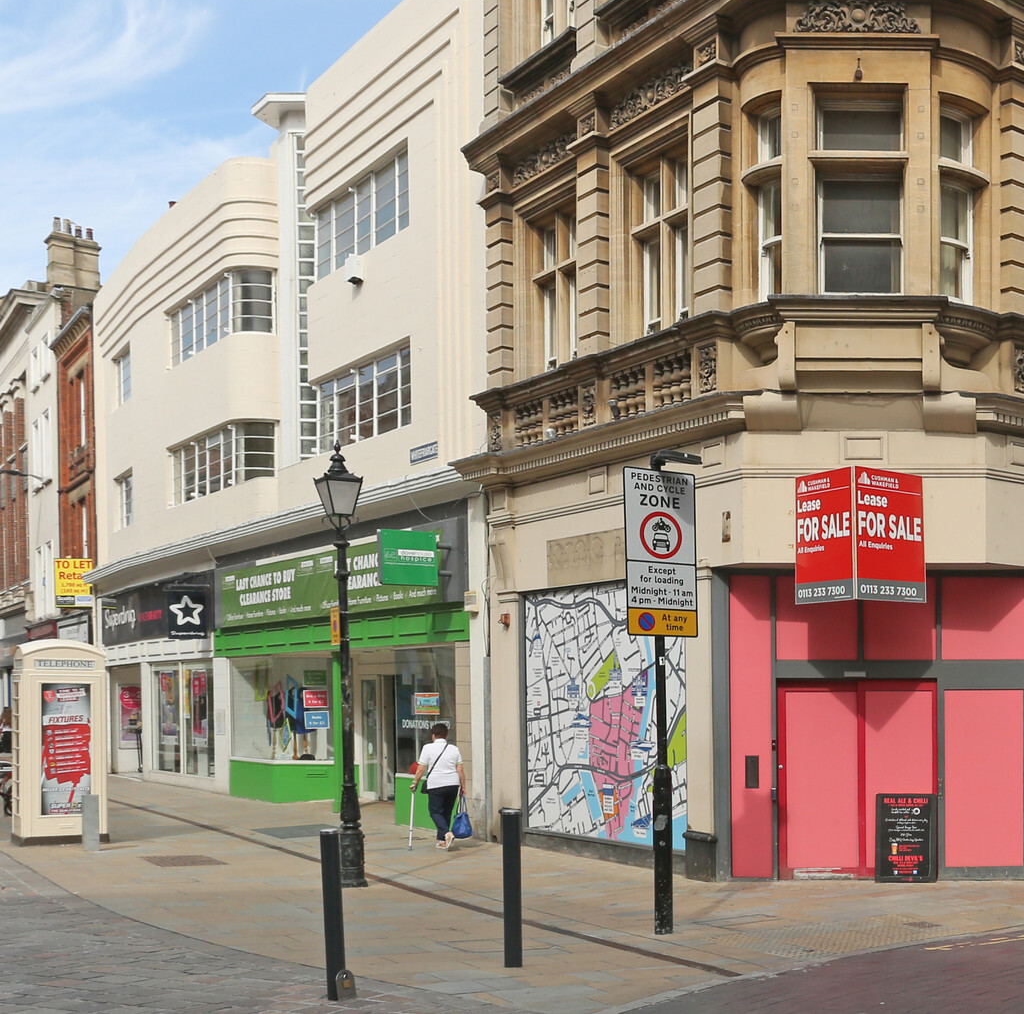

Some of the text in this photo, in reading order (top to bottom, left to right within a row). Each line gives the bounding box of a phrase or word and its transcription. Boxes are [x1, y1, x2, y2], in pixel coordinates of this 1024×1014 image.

[631, 472, 688, 486] PEDESTRIAN
[871, 475, 895, 483] CUSHMAN
[634, 482, 686, 495] AND CYCLE
[807, 483, 831, 492] WAKEFIELD
[871, 480, 899, 489] WAKEFIELD
[640, 494, 680, 509] ZONE
[857, 490, 888, 508] Lease
[797, 499, 821, 514] Lease
[797, 511, 851, 543] FOR SALE
[857, 510, 922, 542] FOR SALE
[804, 545, 825, 553] Enquiries
[858, 540, 893, 550] All Enquiries
[55, 560, 92, 569] TO LET
[353, 552, 380, 570] CHANC
[58, 571, 87, 580] Reta
[648, 566, 676, 576] Except
[236, 577, 249, 591] LAST
[249, 573, 272, 589] CHANCE
[272, 571, 282, 585] TO
[283, 568, 296, 583] BUY
[347, 572, 382, 590] EARANC
[640, 575, 684, 586] for loading
[631, 586, 667, 596] Midnight
[798, 585, 846, 598] 0113 233 7300
[860, 584, 917, 596] 0113 233 7300
[240, 586, 292, 606] CLEARANCE STORE
[658, 598, 694, 608] Midnight
[104, 606, 137, 631] Superdrug
[662, 614, 688, 623] At any
[666, 624, 684, 632] time
[38, 659, 93, 668] TELEPHONE
[48, 715, 84, 724] FIXTURES
[402, 719, 430, 729] DONATIONS
